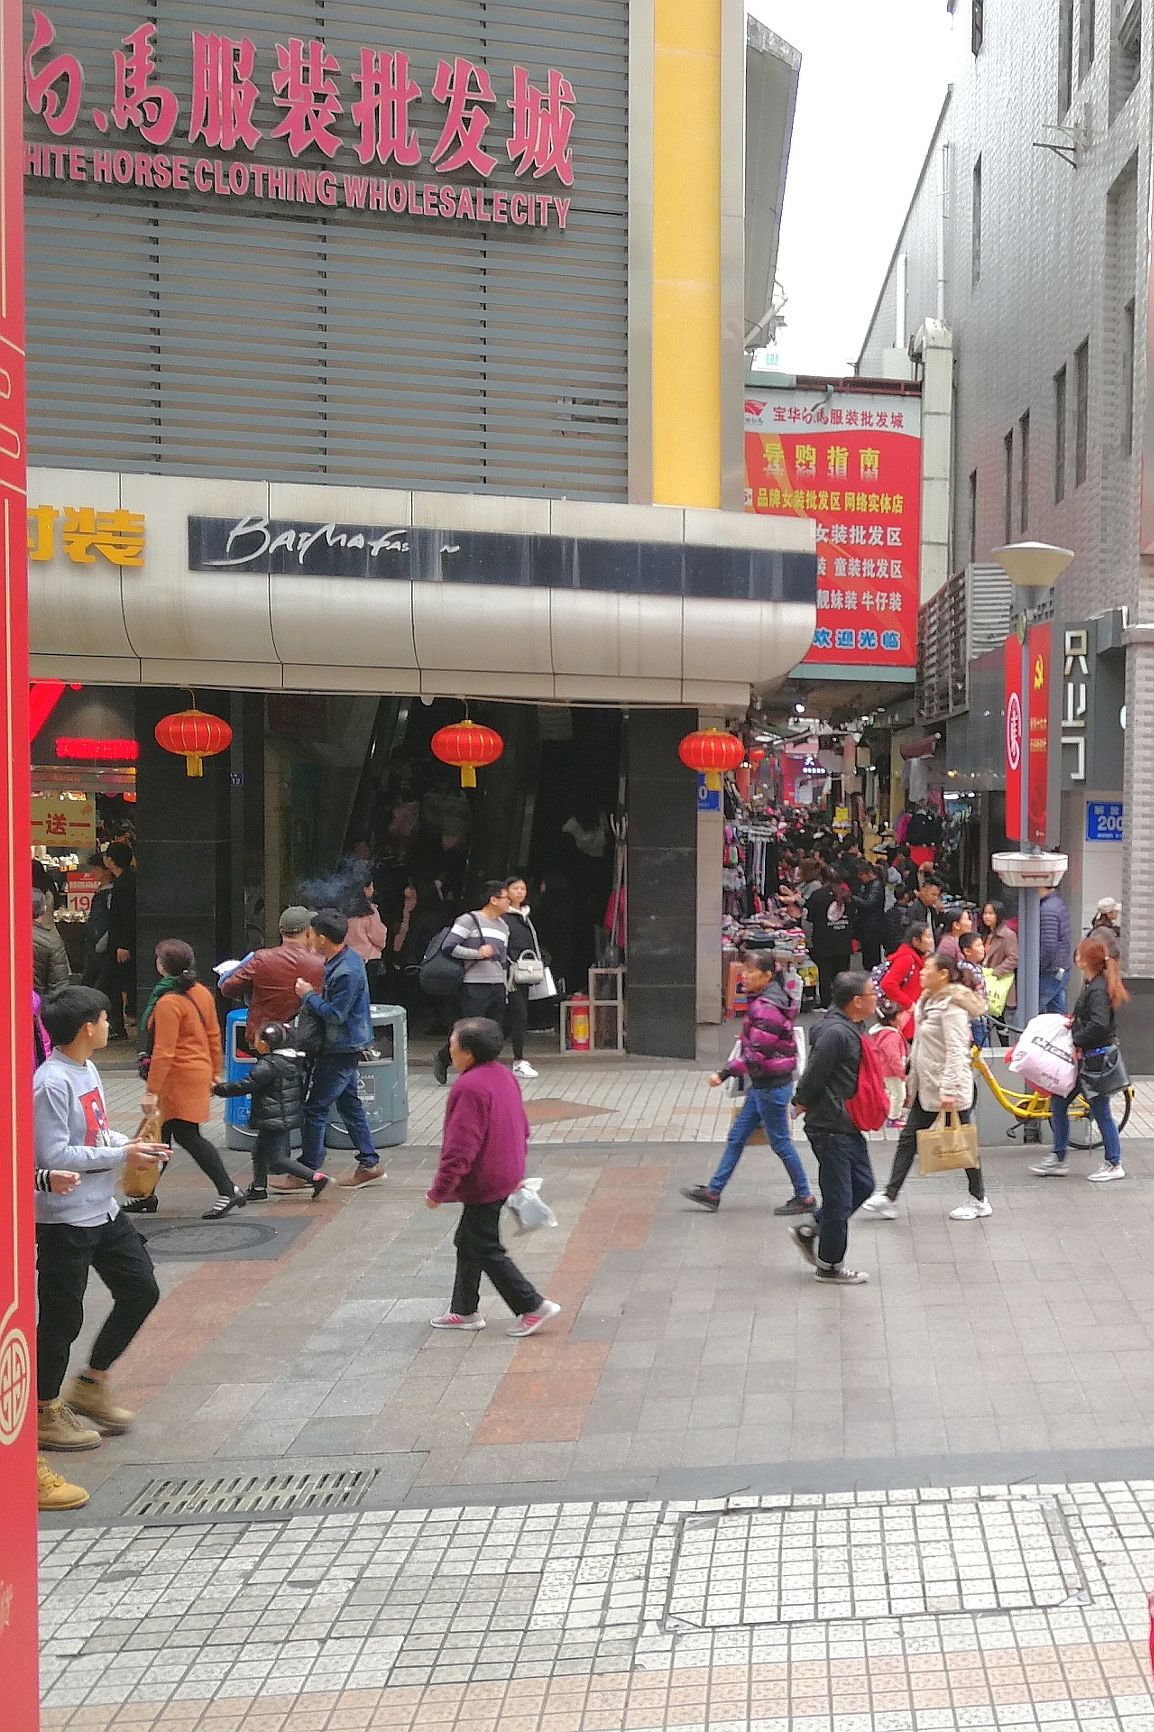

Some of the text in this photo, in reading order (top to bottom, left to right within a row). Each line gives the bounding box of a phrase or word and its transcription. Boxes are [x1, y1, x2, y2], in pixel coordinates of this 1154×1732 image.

[94, 149, 190, 190] HORSE
[194, 158, 337, 205] CLOTHING
[763, 443, 881, 468] 导购指南
[757, 487, 842, 511] 品牌女装批发区
[844, 491, 904, 514] 网络实体店
[816, 523, 903, 547] 女装批发区
[834, 557, 903, 579] 童装批发区
[861, 591, 903, 612] 牛仔装
[813, 627, 901, 651] 欢迎光临
